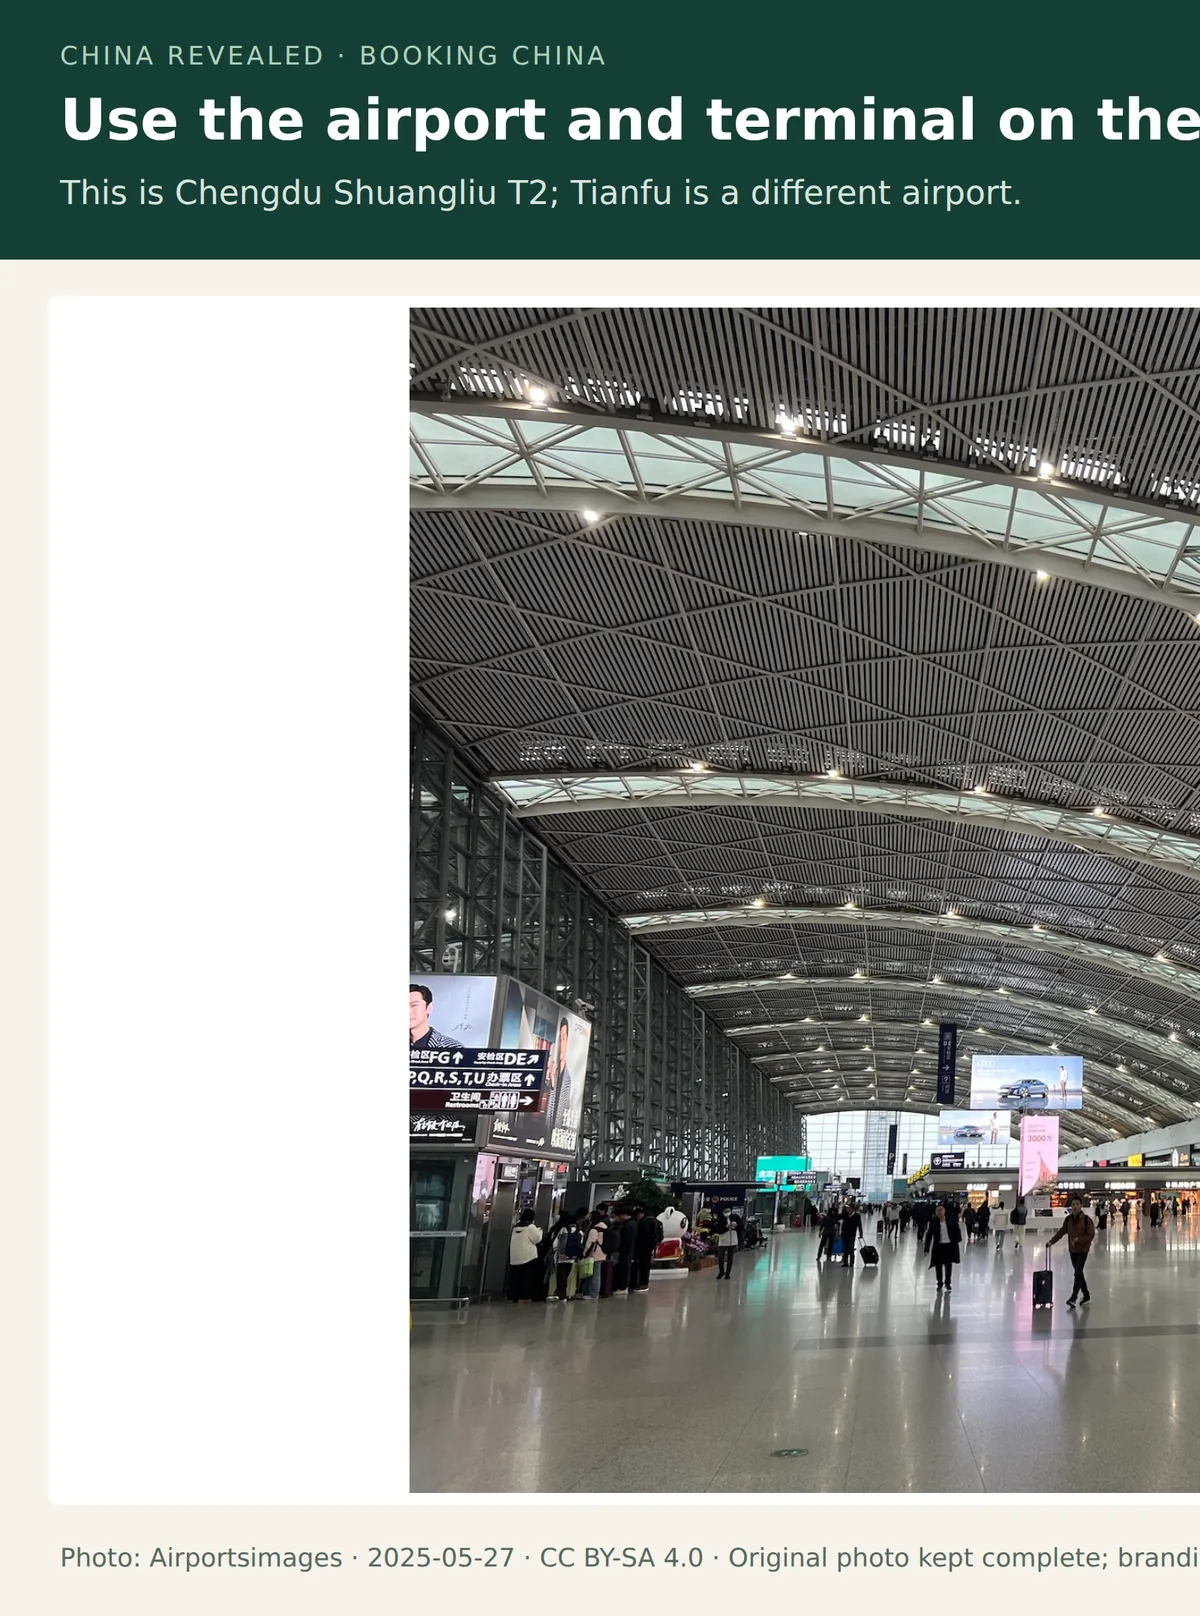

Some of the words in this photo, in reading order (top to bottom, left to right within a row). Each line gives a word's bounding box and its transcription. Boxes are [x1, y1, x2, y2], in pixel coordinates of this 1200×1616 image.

[409, 1049, 430, 1059] 检区
[429, 1051, 451, 1064] FG
[477, 1051, 505, 1061] 安检区
[503, 1052, 527, 1065] DE
[486, 1071, 523, 1082] 办票区
[450, 1092, 482, 1102] 卫生间
